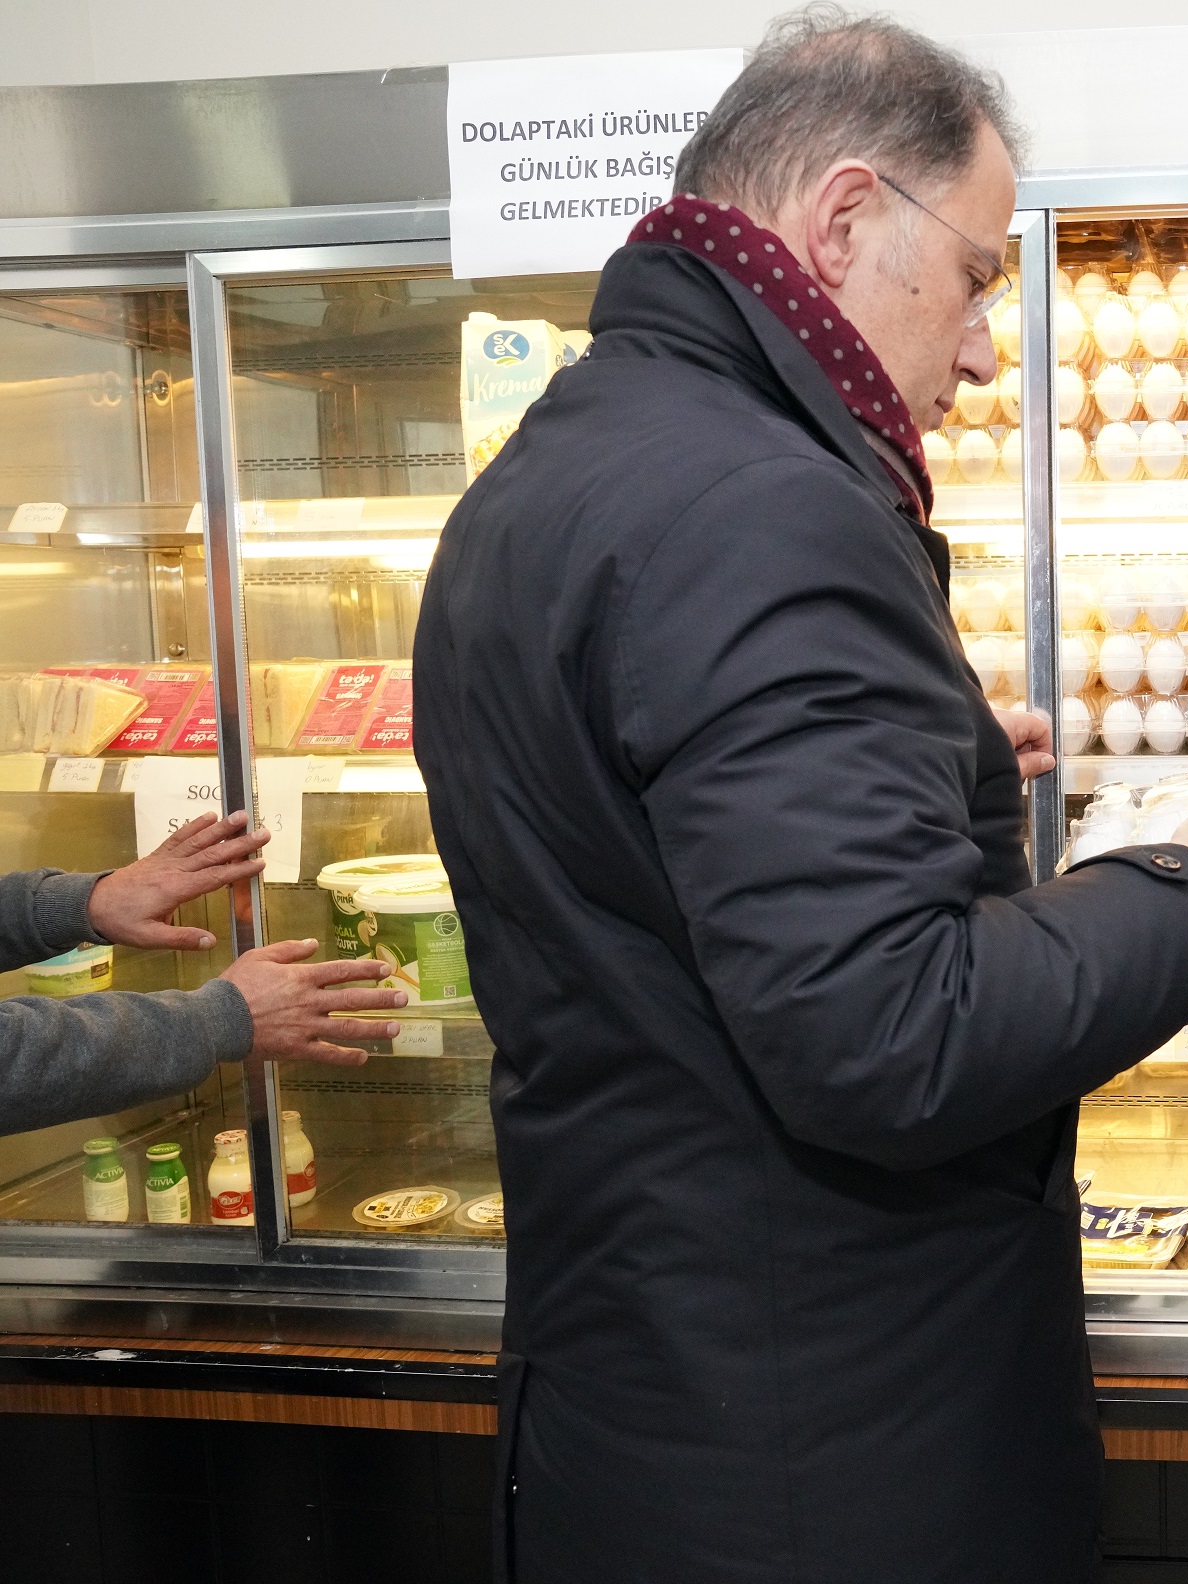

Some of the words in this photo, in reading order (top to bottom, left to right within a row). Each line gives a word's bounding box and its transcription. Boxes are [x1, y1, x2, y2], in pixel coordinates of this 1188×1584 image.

[461, 113, 594, 143] DOLAPTAKİ
[500, 155, 598, 183] GÜNLÜK
[605, 151, 675, 180] BAĞIŞ
[500, 193, 662, 221] GELMEKTEDİR
[473, 373, 547, 406] Krema
